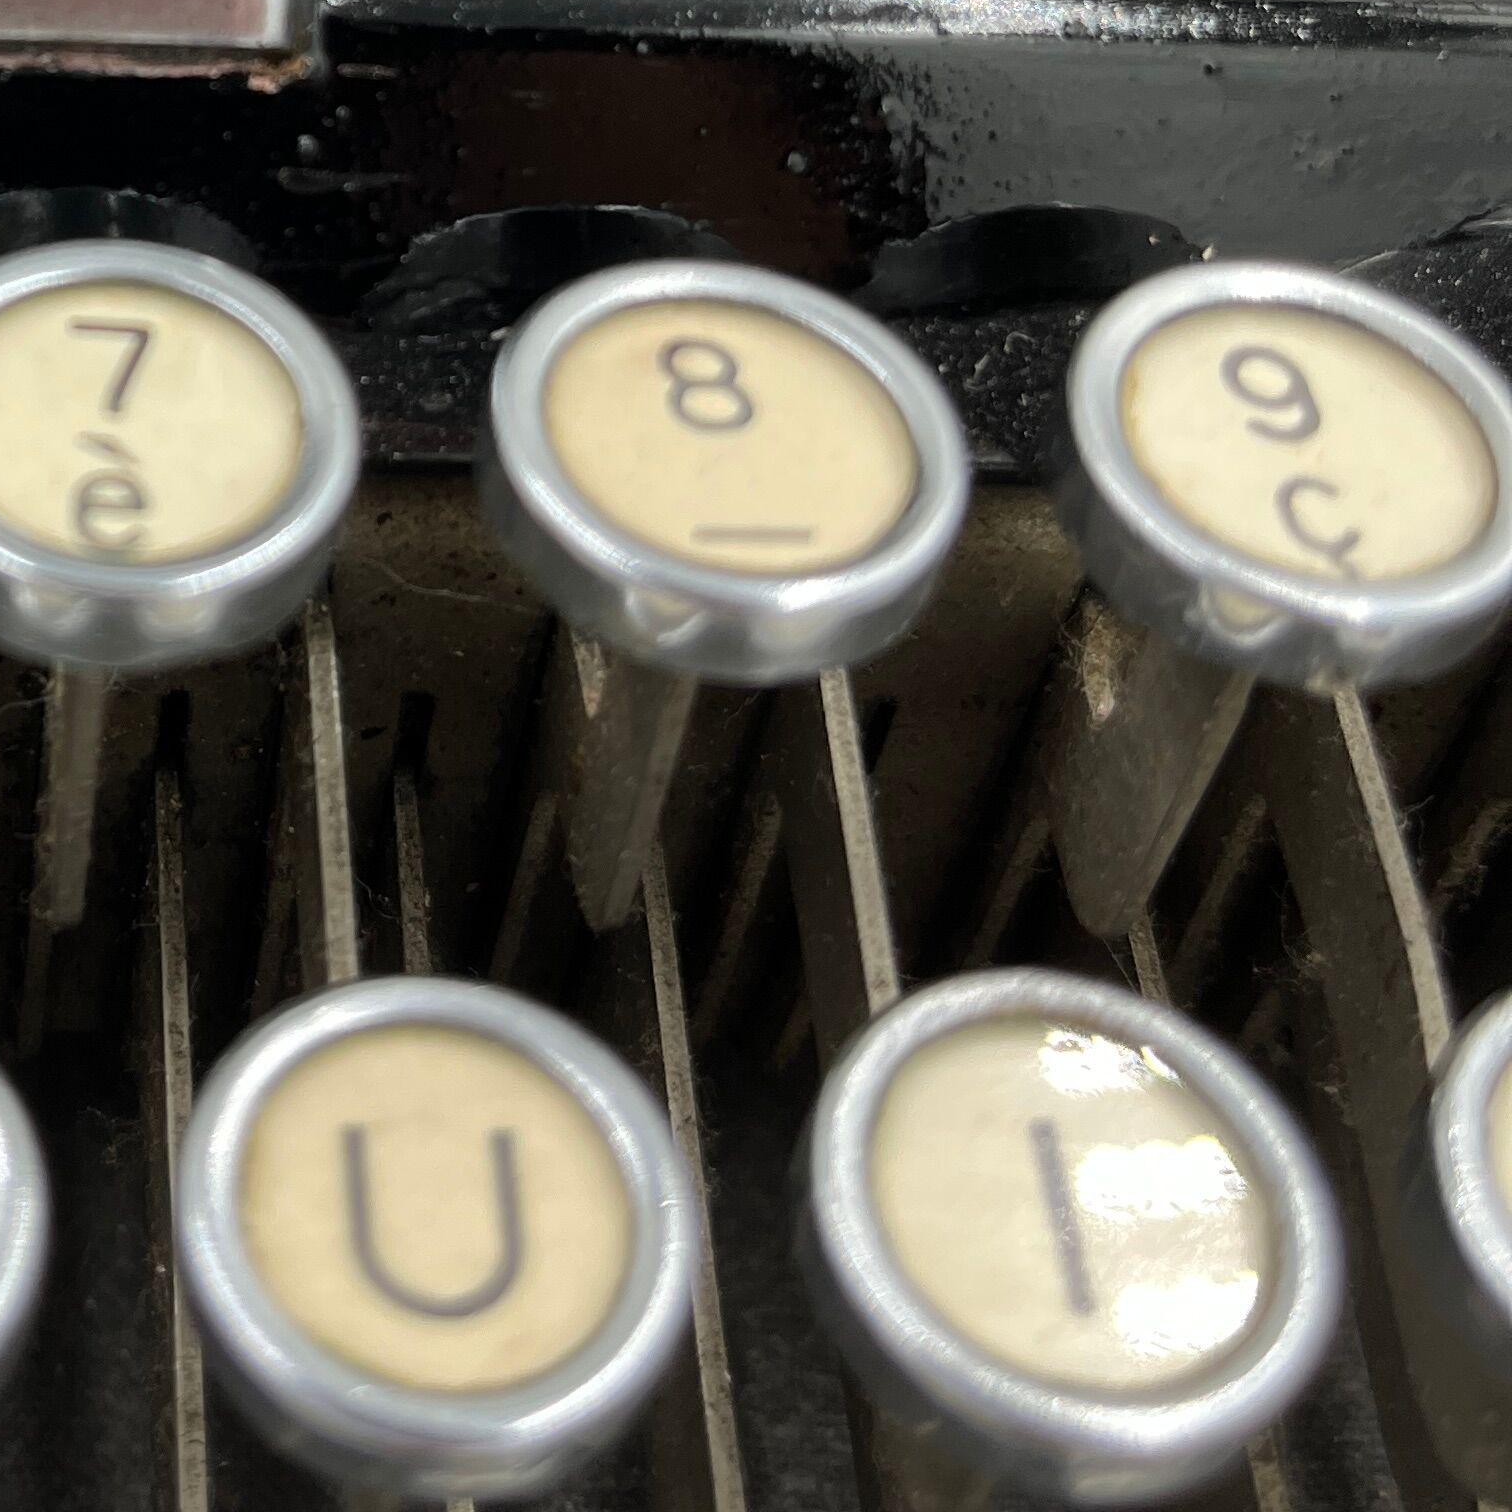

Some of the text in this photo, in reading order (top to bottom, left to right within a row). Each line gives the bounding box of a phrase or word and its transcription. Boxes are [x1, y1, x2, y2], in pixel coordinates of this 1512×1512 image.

[68, 315, 153, 414] 7
[656, 336, 753, 431] 8
[1218, 343, 1322, 443] 9
[74, 431, 148, 550] è
[340, 1122, 523, 1319] U
[1028, 1117, 1095, 1315] I
